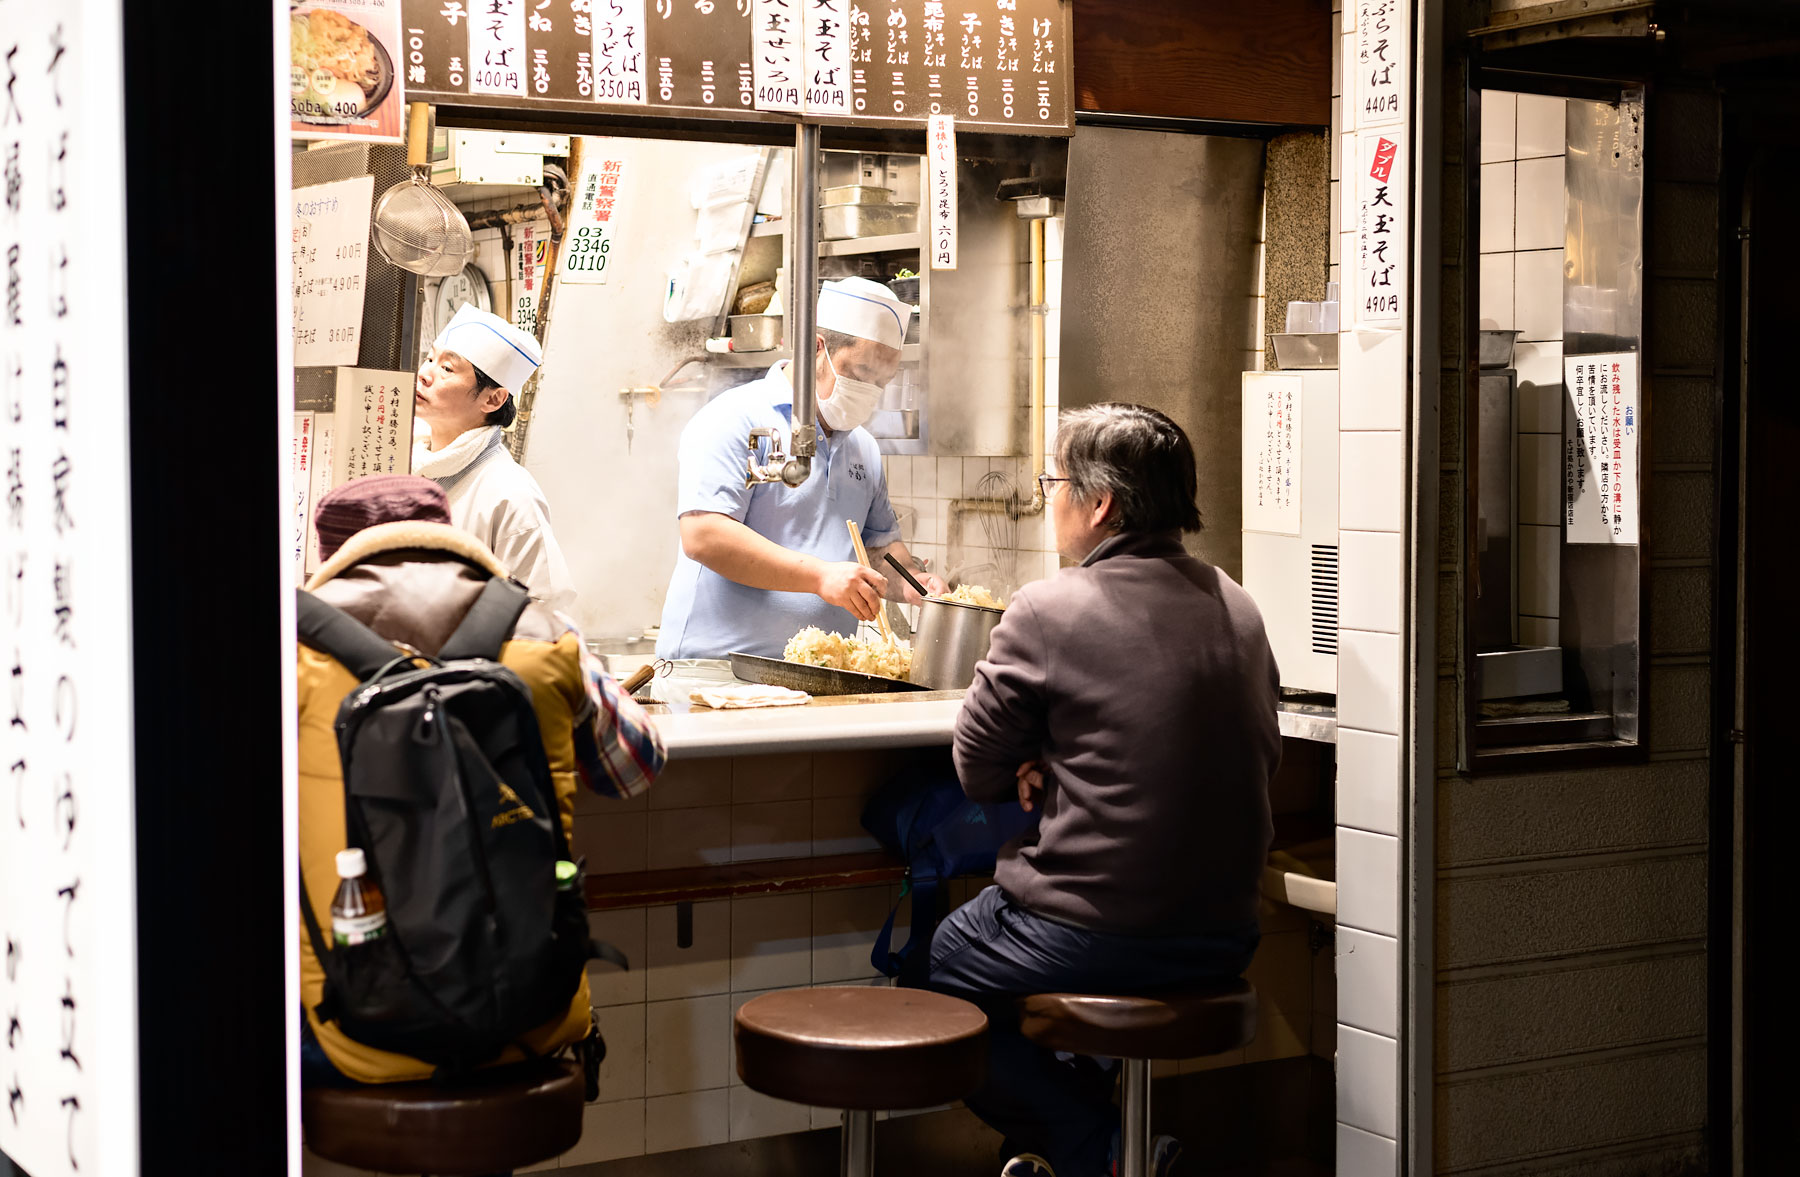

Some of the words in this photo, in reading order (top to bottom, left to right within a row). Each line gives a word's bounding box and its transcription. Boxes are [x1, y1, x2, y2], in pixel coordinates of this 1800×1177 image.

[440, 1, 467, 26] 子
[887, 8, 907, 28] め
[923, 1, 945, 32] 昆布
[960, 13, 982, 34] 子
[1032, 17, 1052, 38] け
[599, 21, 620, 77] うどん
[622, 26, 641, 74] そば
[850, 26, 860, 62] うどん
[860, 28, 871, 63] そば
[886, 28, 897, 64] うどん
[898, 30, 909, 65] そば
[923, 32, 934, 66] うどん
[935, 33, 946, 67] そば
[960, 34, 971, 69] うどん
[972, 35, 983, 69] そば
[997, 37, 1007, 71] うどん
[1008, 38, 1019, 71] そば
[1032, 39, 1043, 73] うどん
[1044, 40, 1055, 73] そば
[448, 57, 464, 87] 五〇
[475, 70, 518, 90] 400円
[533, 49, 551, 94] 三九〇
[576, 52, 593, 96] 三九〇
[658, 57, 674, 101] 三五〇
[701, 60, 716, 104] 三二〇
[738, 62, 753, 106] 二五〇
[291, 98, 321, 112] Soba
[599, 79, 641, 101] 350円
[759, 86, 798, 105] 400円
[806, 88, 844, 107] 400円
[853, 69, 867, 111] 三一〇
[891, 72, 906, 112] 三一〇
[928, 74, 942, 114] 三一〇
[966, 76, 979, 117] 三〇〇
[1001, 78, 1015, 118] 三〇〇
[1037, 80, 1051, 120] 二五〇
[1365, 93, 1398, 114] 440円
[1373, 141, 1397, 178] ダブル
[582, 173, 597, 211] 直通電話
[592, 160, 622, 222] 新宿警察署
[938, 170, 950, 220] とろろ昆布
[571, 238, 610, 254] 3346
[578, 227, 603, 238] 03
[1371, 186, 1395, 287] 天玉そば
[335, 243, 361, 260] 400円
[524, 227, 534, 291] 新宿警察署
[568, 254, 606, 271] 0110
[332, 275, 360, 291] 490円
[517, 309, 536, 325] 3346
[518, 297, 531, 308] 03
[1365, 295, 1398, 314] 490円
[328, 326, 355, 343] 360円
[1588, 364, 1597, 460] 苦情を頂いています。
[1625, 405, 1634, 436] お願い
